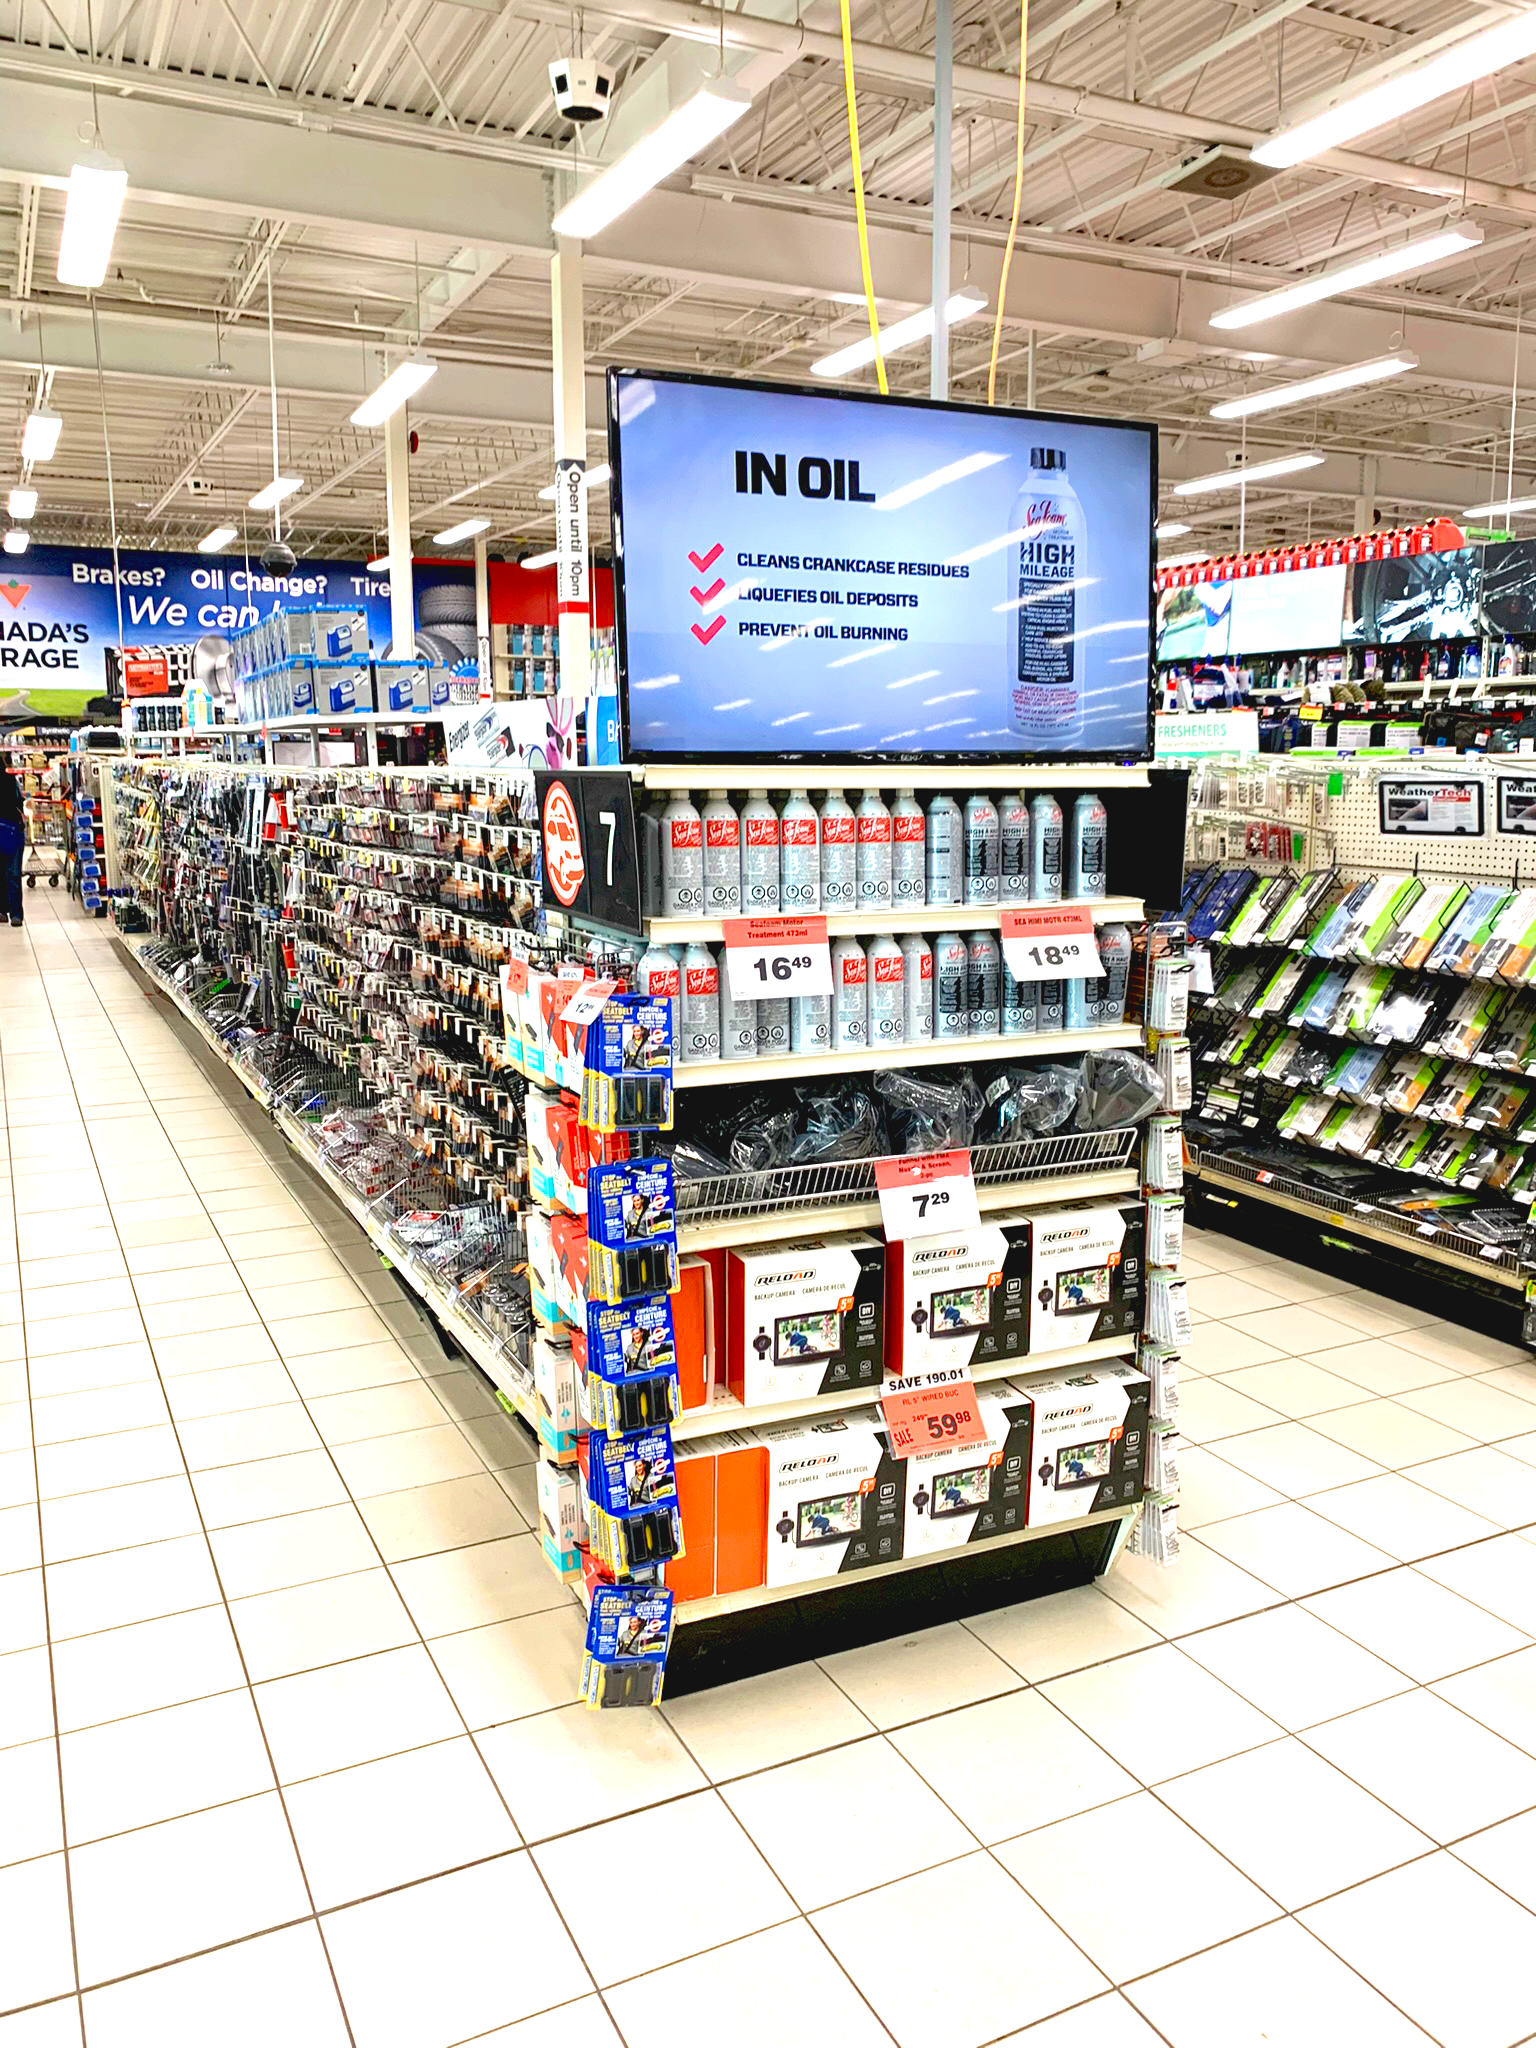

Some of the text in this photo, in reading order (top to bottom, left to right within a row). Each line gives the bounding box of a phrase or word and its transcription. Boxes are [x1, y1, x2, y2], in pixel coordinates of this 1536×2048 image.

[735, 450, 876, 503] IN OIL
[567, 471, 582, 596] Open until 10pm
[1020, 542, 1075, 565] HIGH
[737, 553, 970, 578] CLEANS CRANKCASE RESIDUES
[1020, 563, 1074, 578] MILEAGE
[71, 562, 166, 587] Brakes?
[191, 568, 224, 591] Oil
[229, 571, 328, 597] Change?
[738, 587, 918, 607] LIQUEFIES OIL DEPOSITS
[128, 595, 259, 629] We can
[739, 621, 908, 641] PREVENT OIL BURNING
[449, 720, 470, 753] Energizer
[1158, 723, 1227, 738] FRESHENERS
[1388, 787, 1472, 797] WeatherTech
[599, 811, 616, 887] 7
[1014, 918, 1026, 926] SEA
[747, 930, 784, 939] Treatment
[1043, 1228, 1089, 1242] RELOAD
[915, 1248, 966, 1262] RELOAD
[757, 1270, 814, 1285] RELOAD
[931, 1266, 950, 1274] CAMERA
[754, 1290, 796, 1301] BACKUP CAMERA
[889, 1369, 964, 1391] SAVE 190.01
[921, 1391, 944, 1402] WIRED
[1044, 1405, 1092, 1420] RELOAD
[893, 1428, 914, 1448] SALE
[782, 1455, 837, 1471] RELOAD
[779, 1475, 819, 1487] BACKUP CAMERA
